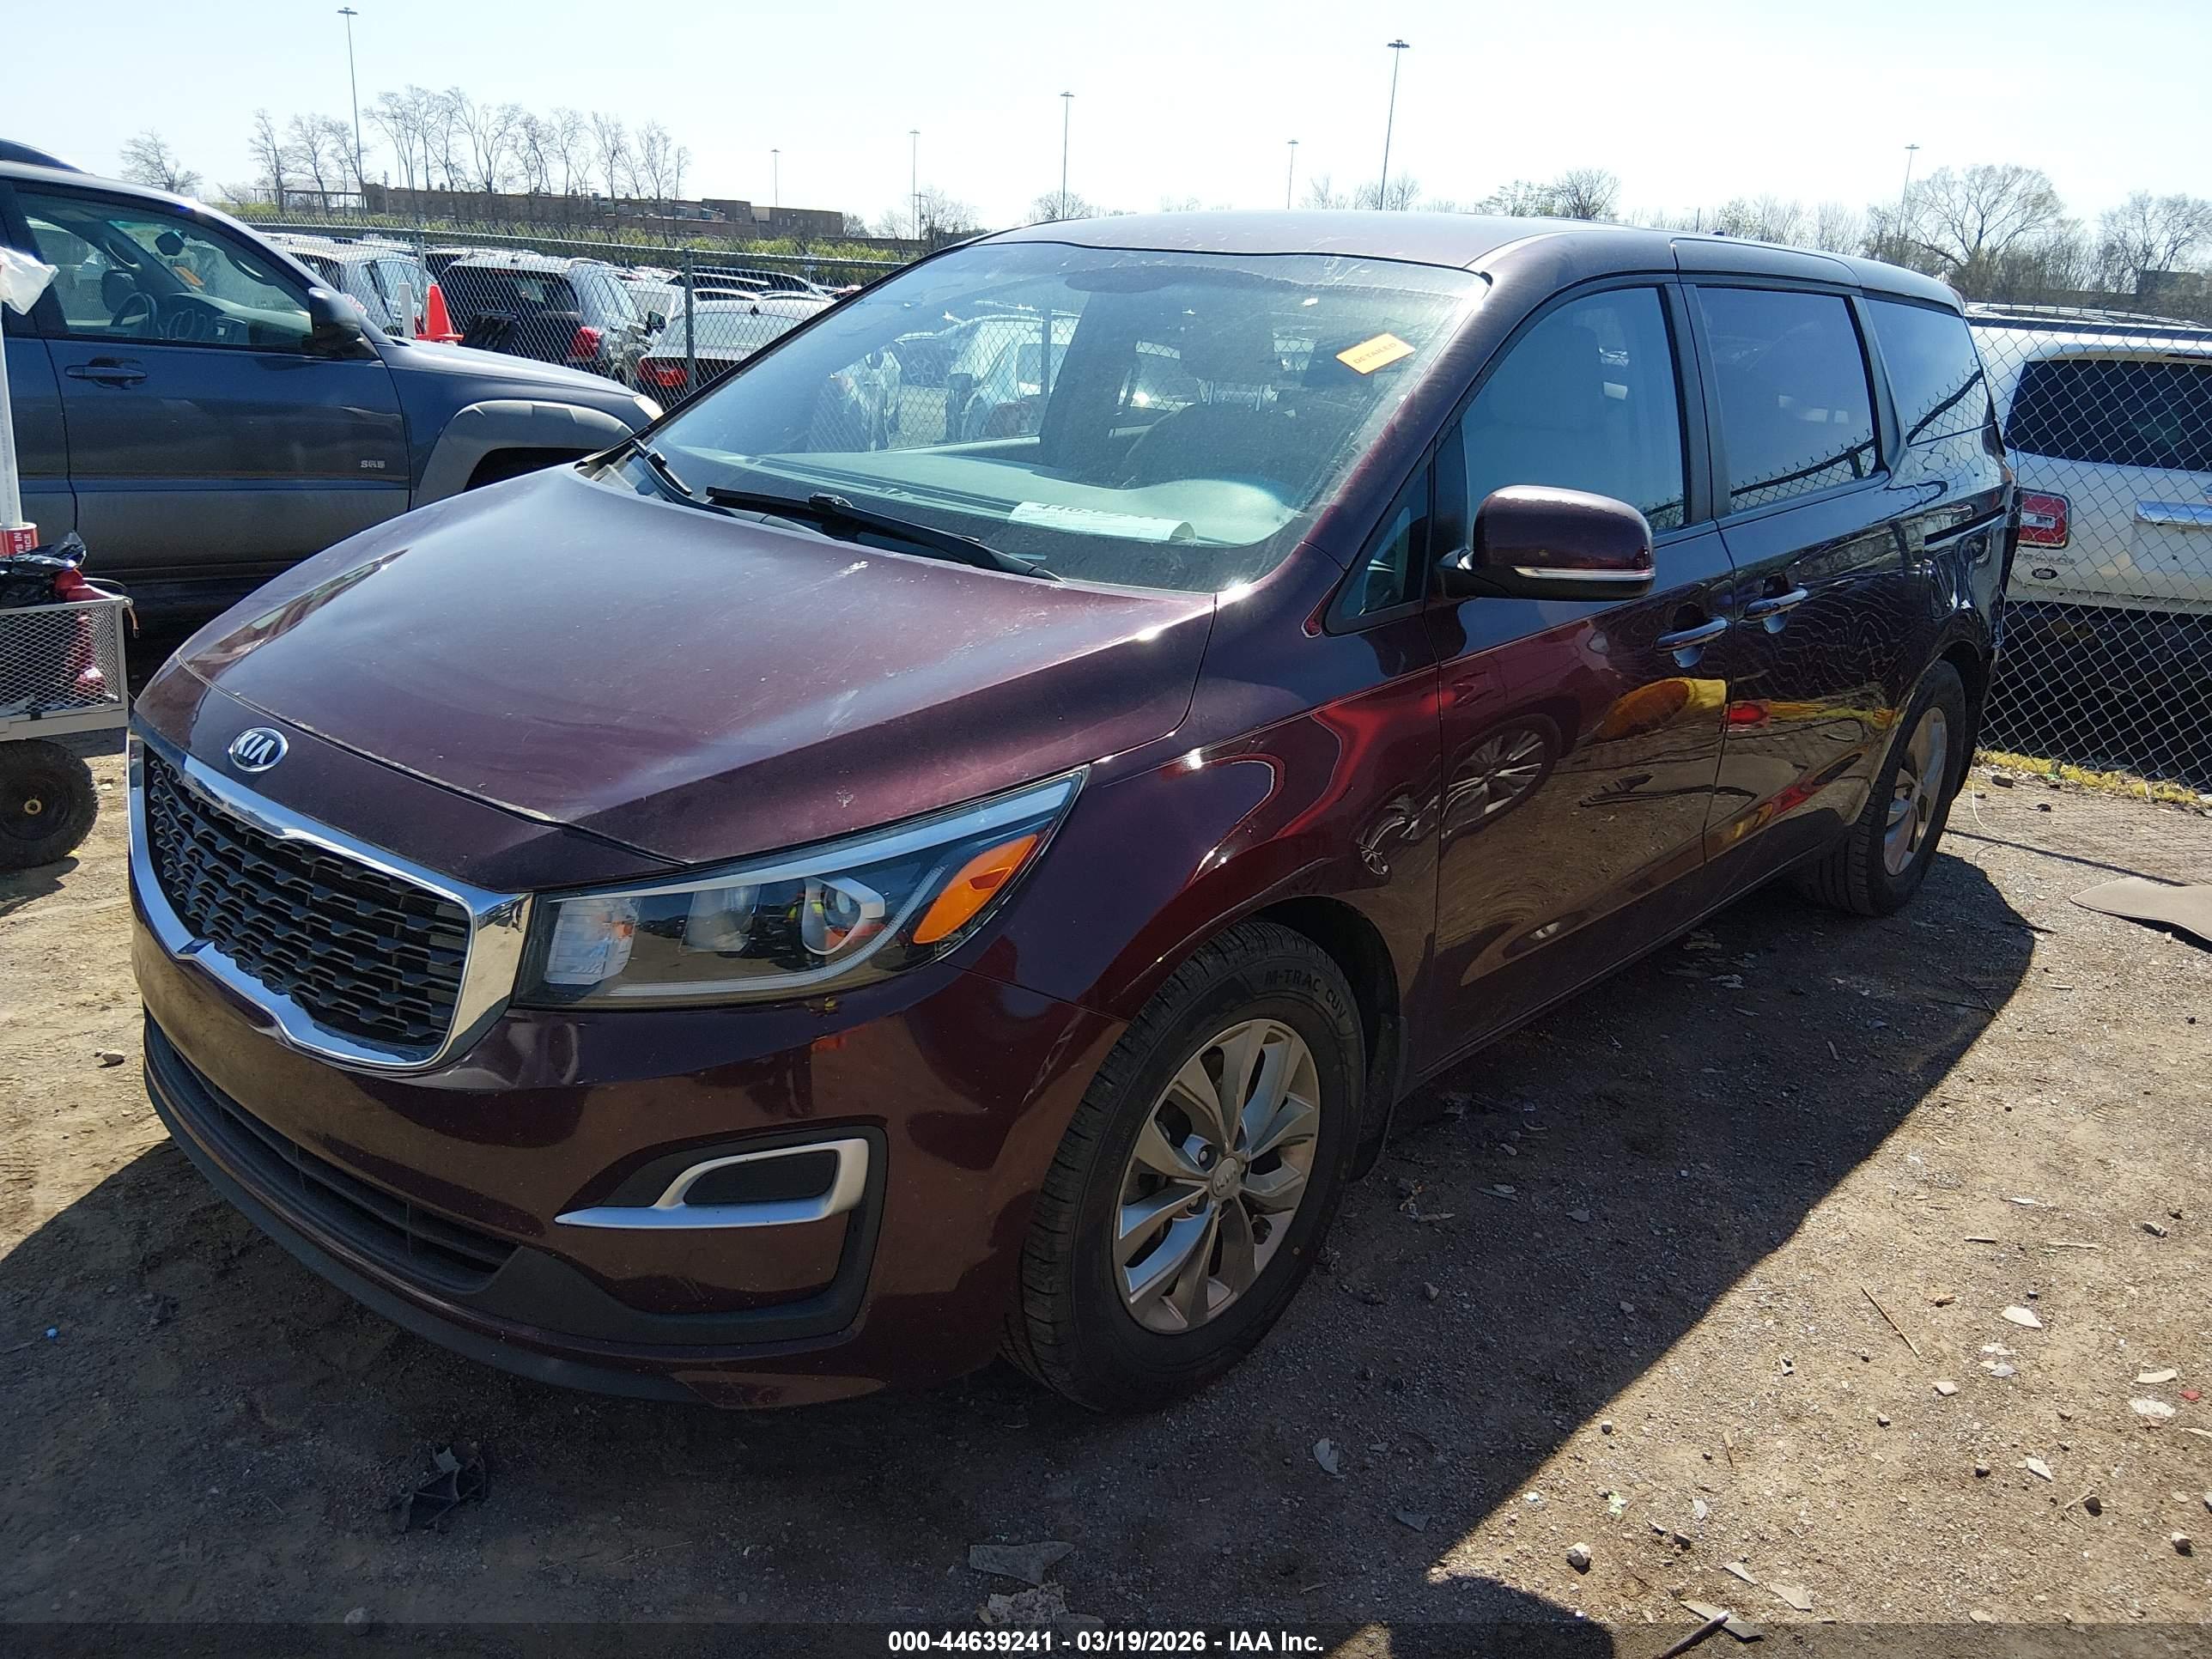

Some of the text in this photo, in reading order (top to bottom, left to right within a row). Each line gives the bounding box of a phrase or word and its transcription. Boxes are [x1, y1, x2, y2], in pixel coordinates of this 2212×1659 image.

[1352, 343, 1397, 364] DETAILED
[238, 731, 276, 764] KIA
[1264, 969, 1347, 1019] M-TRAC CUV
